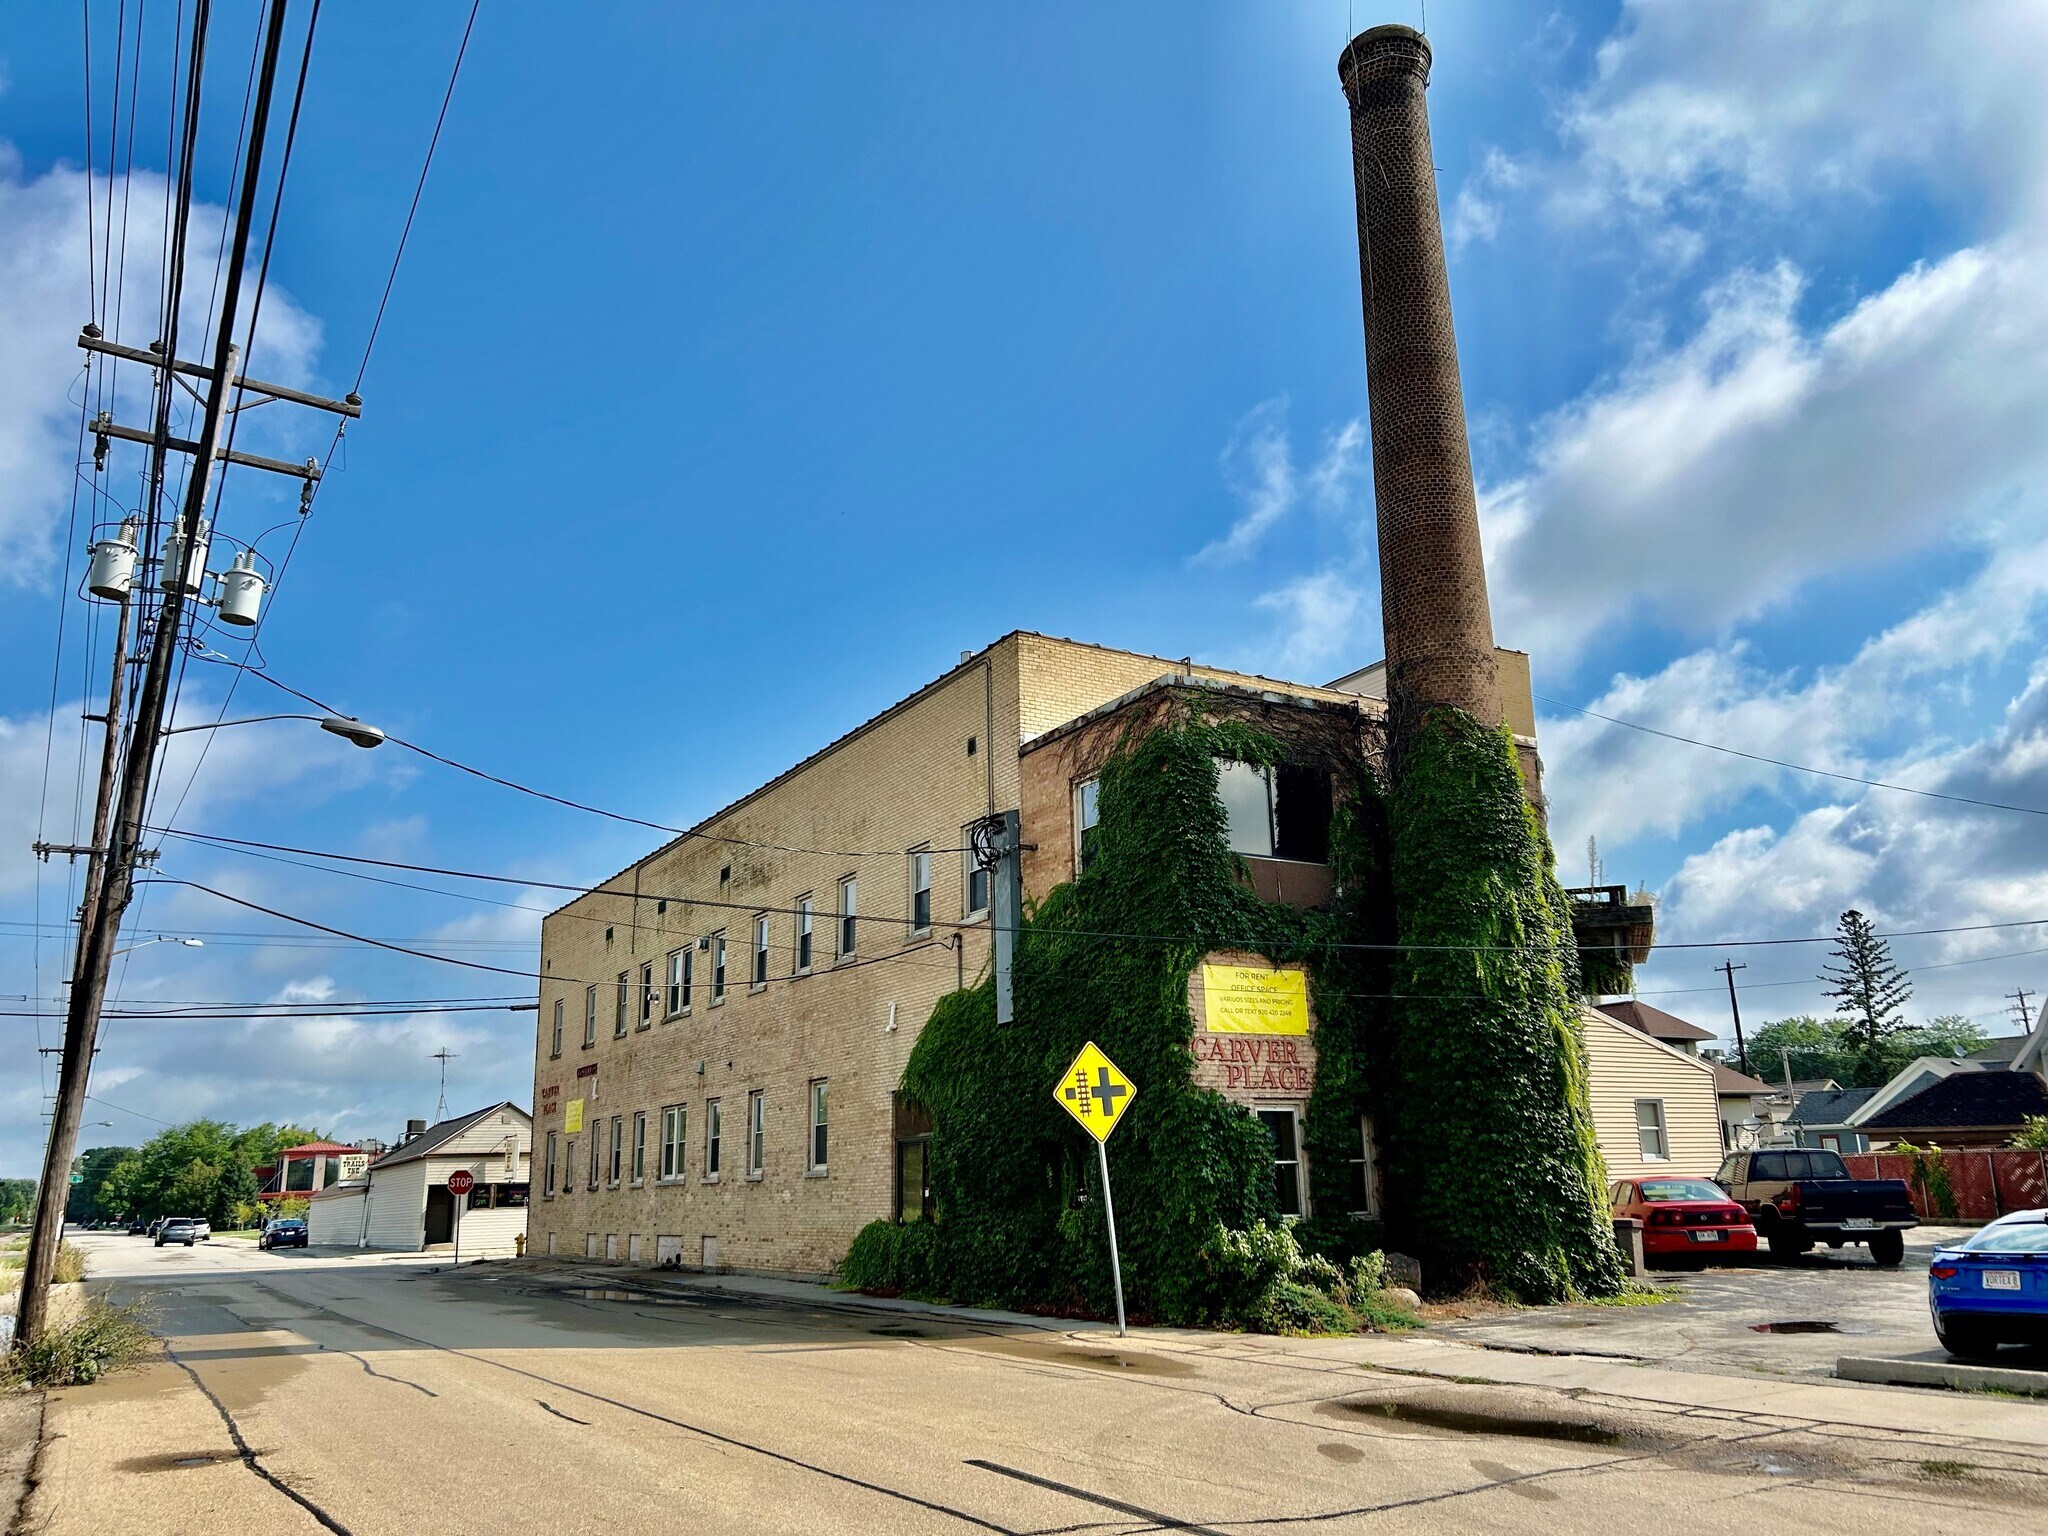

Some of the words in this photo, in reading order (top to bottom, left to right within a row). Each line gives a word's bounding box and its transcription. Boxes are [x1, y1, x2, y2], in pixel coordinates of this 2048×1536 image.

[1251, 973, 1269, 981] RENT
[1231, 984, 1255, 992] OFFICE
[1191, 1036, 1300, 1064] CARVER
[1227, 1065, 1310, 1090] PLACE
[450, 1177, 472, 1188] STOP
